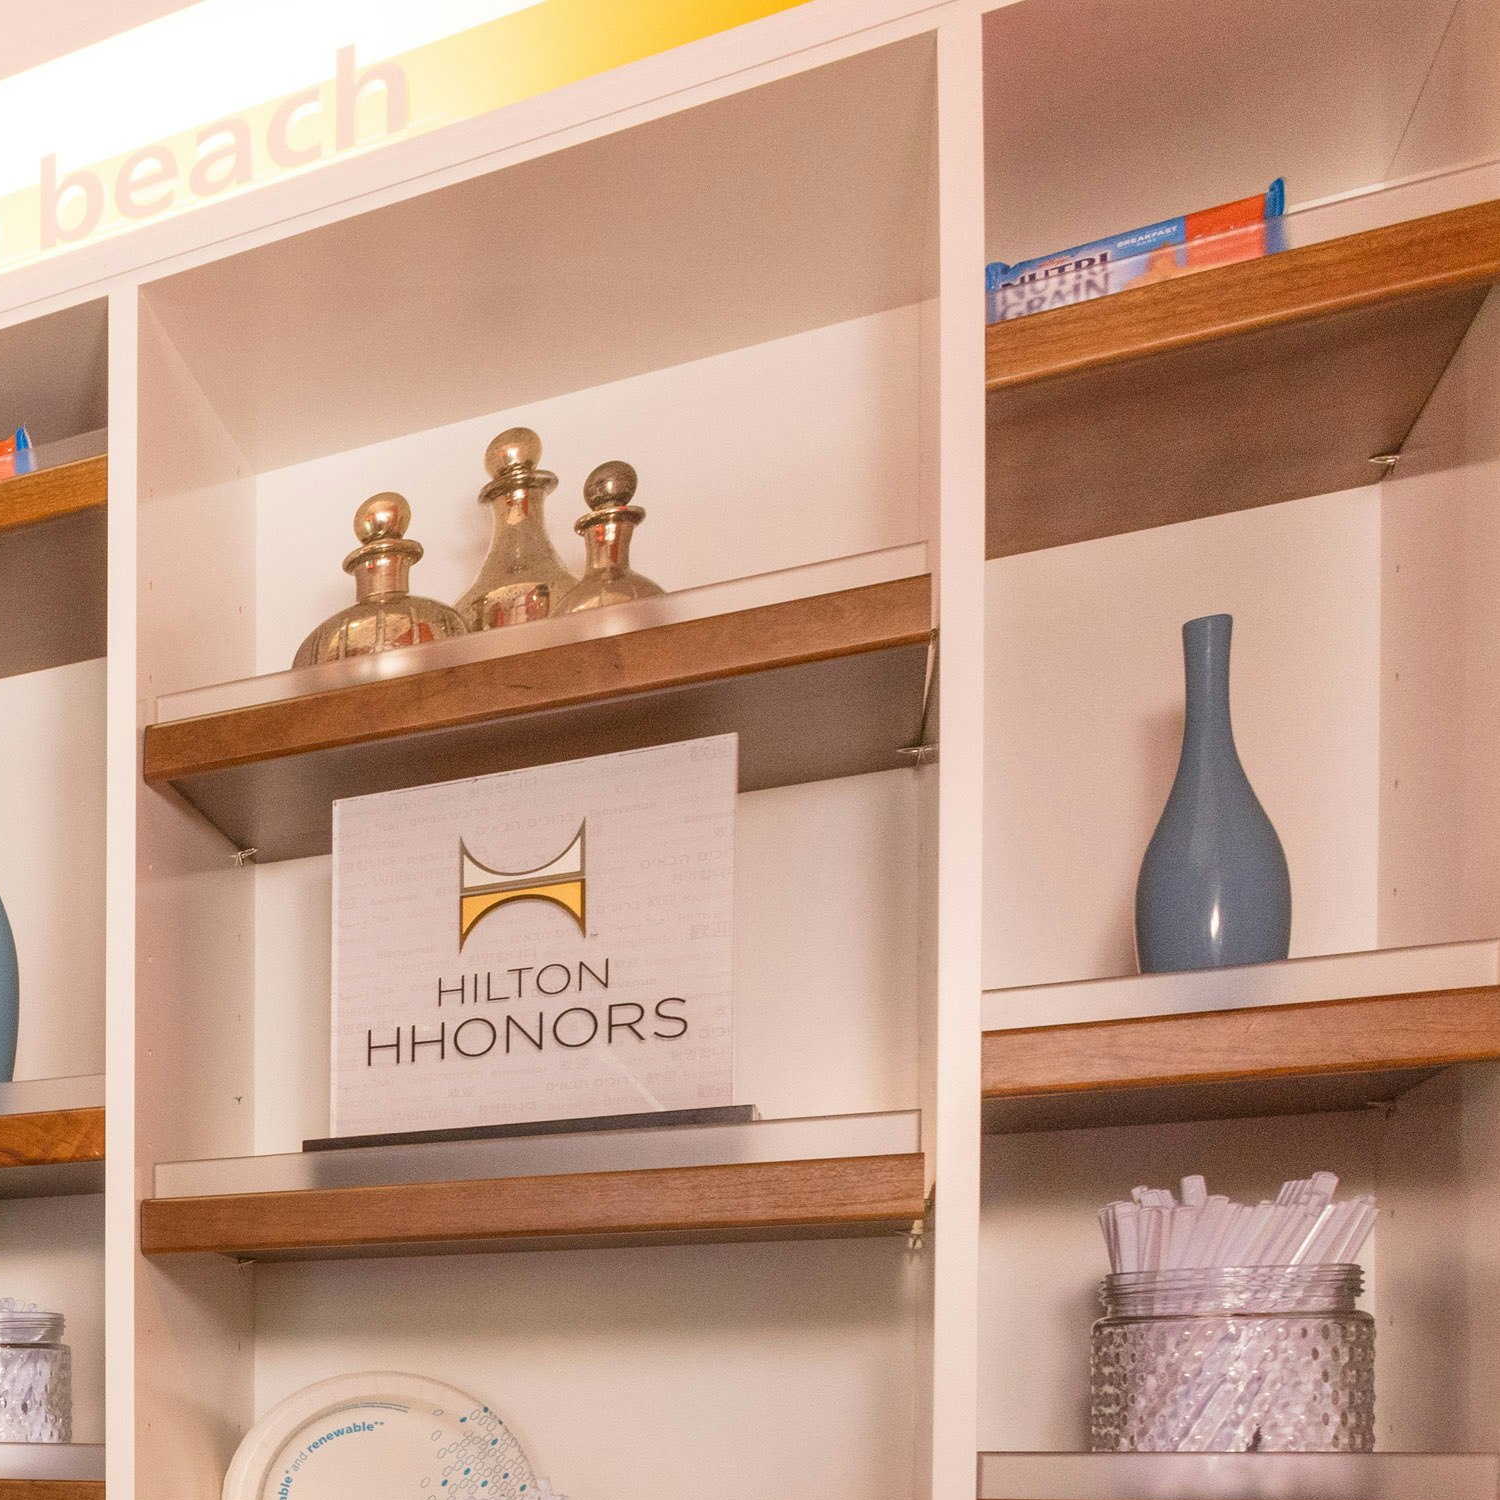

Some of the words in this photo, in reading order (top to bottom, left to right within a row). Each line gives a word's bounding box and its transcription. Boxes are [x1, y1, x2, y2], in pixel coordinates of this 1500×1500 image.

[37, 45, 407, 252] beach
[438, 958, 609, 1007] HILTON
[367, 997, 688, 1066] HHONORS
